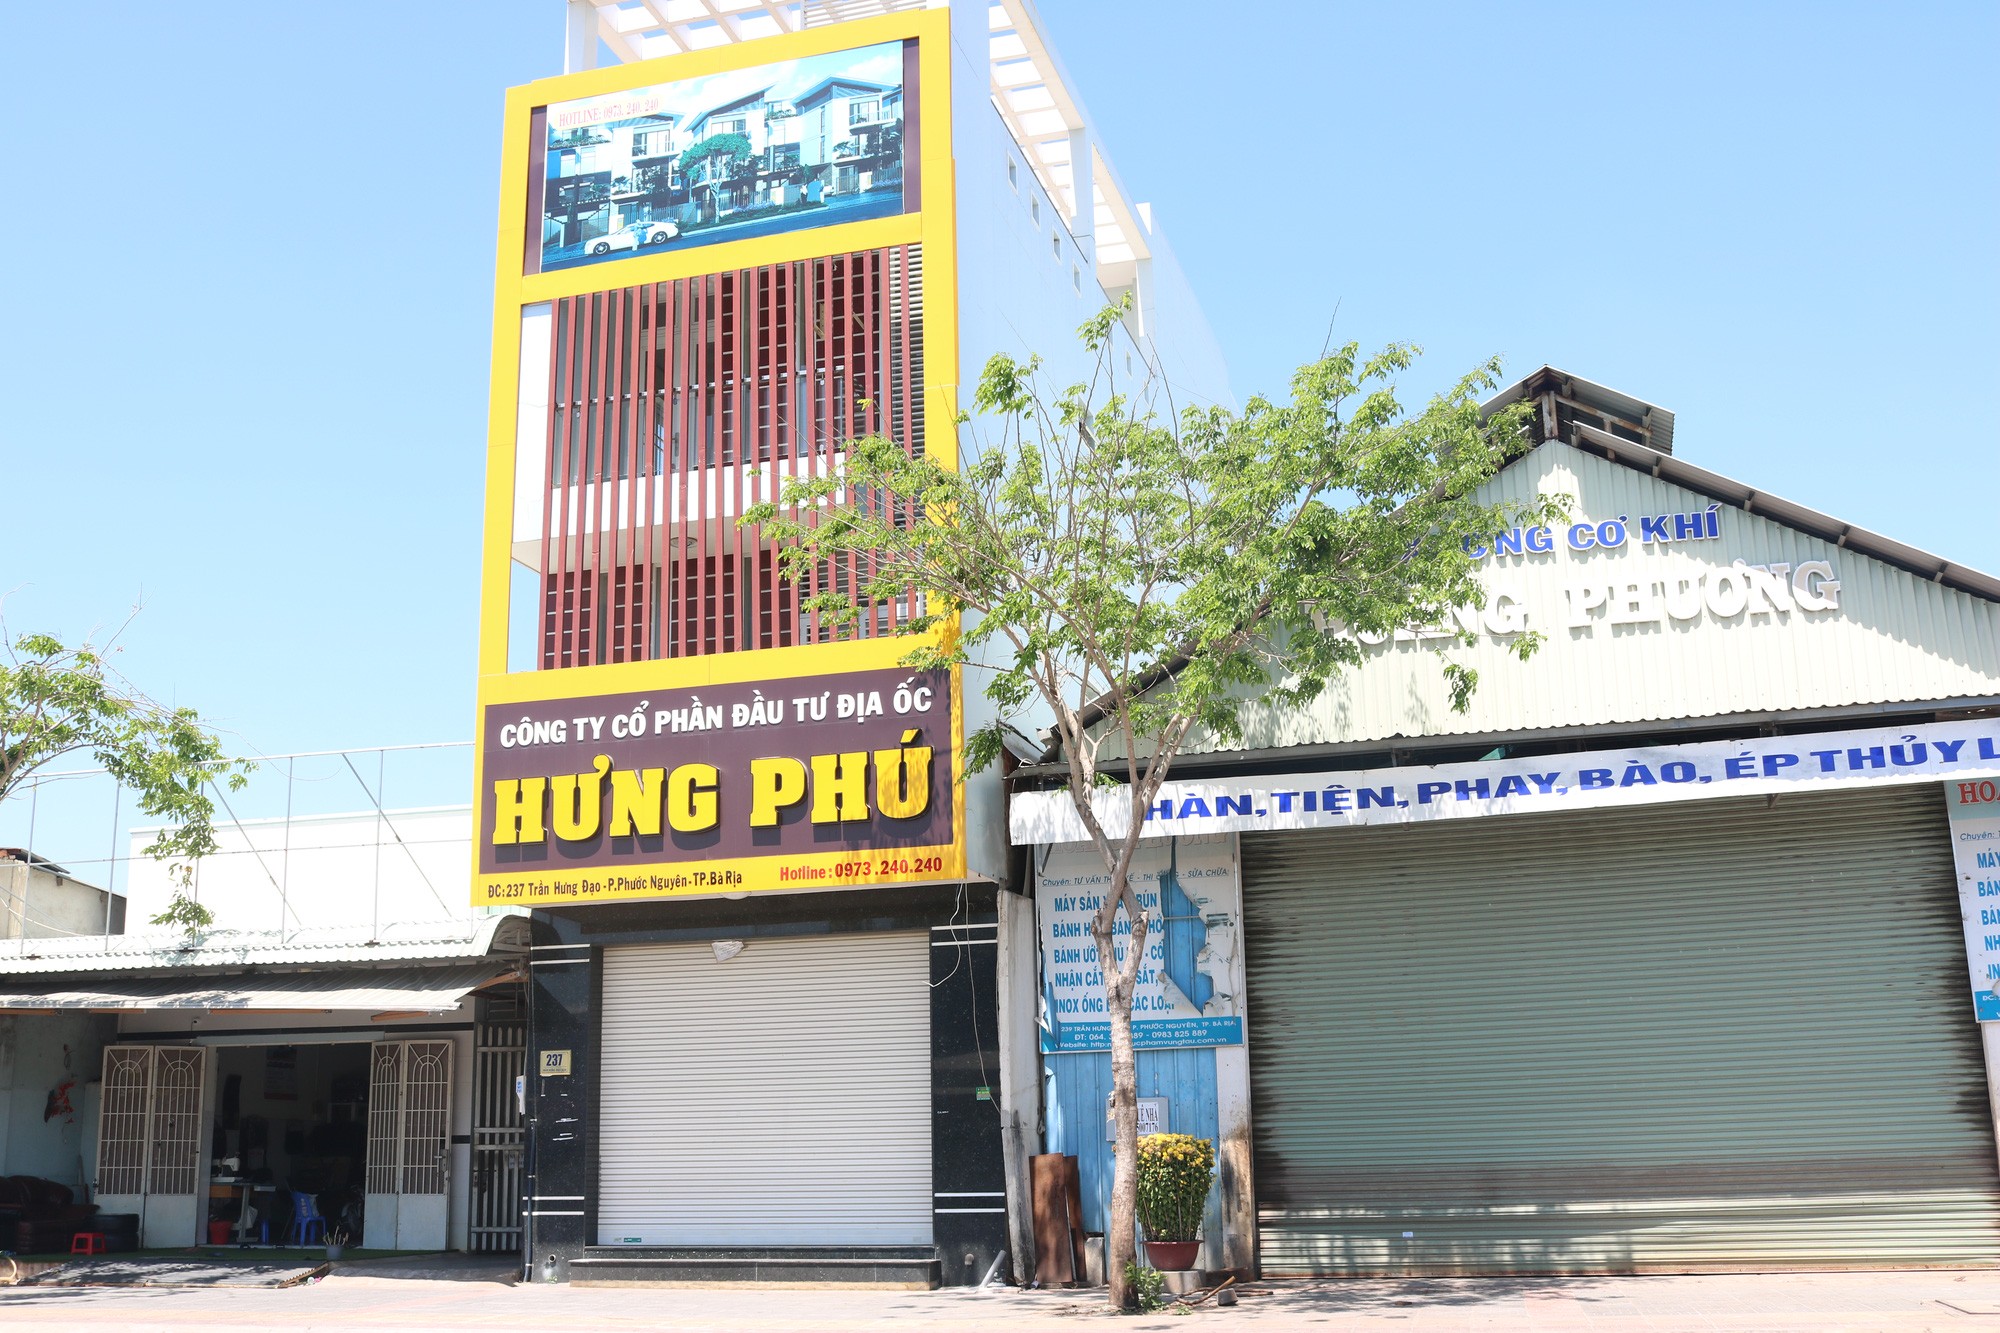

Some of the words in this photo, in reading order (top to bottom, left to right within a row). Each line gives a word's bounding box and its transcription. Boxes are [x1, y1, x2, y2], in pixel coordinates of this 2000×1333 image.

[560, 107, 601, 127] HOTLINE:
[645, 98, 659, 111] 240
[1567, 514, 1628, 550] CƠ
[1639, 502, 1723, 544] KHÍ
[500, 716, 567, 748] CÔNG
[573, 716, 606, 742] TY
[611, 700, 650, 739] CỔ
[654, 695, 723, 735] PHẦN
[731, 689, 784, 728] ĐẦU
[792, 690, 830, 722] TƯ
[837, 691, 883, 724] ĐỊA
[893, 676, 932, 715] ỐC
[1417, 772, 1568, 805] PHAY,
[1578, 760, 1713, 791] BÀO,
[1725, 751, 1800, 779] ÉP
[1810, 734, 1967, 774] THỦY
[492, 754, 720, 846] HƯNG
[749, 728, 933, 829] PHÚ
[1957, 780, 2000, 804] HO
[528, 880, 549, 896] Trần
[554, 881, 578, 897] Hưng
[582, 879, 601, 896] Đạo
[1054, 894, 1076, 912] MÁY
[1080, 891, 1100, 911] SẢN
[1052, 920, 1081, 938] BÁNH
[1054, 945, 1080, 963] BÁNH
[1055, 969, 1083, 991] NHẬN
[1082, 992, 1103, 1013] ỐNG
[1192, 1029, 1207, 1037] 889
[546, 1054, 563, 1067] 237
